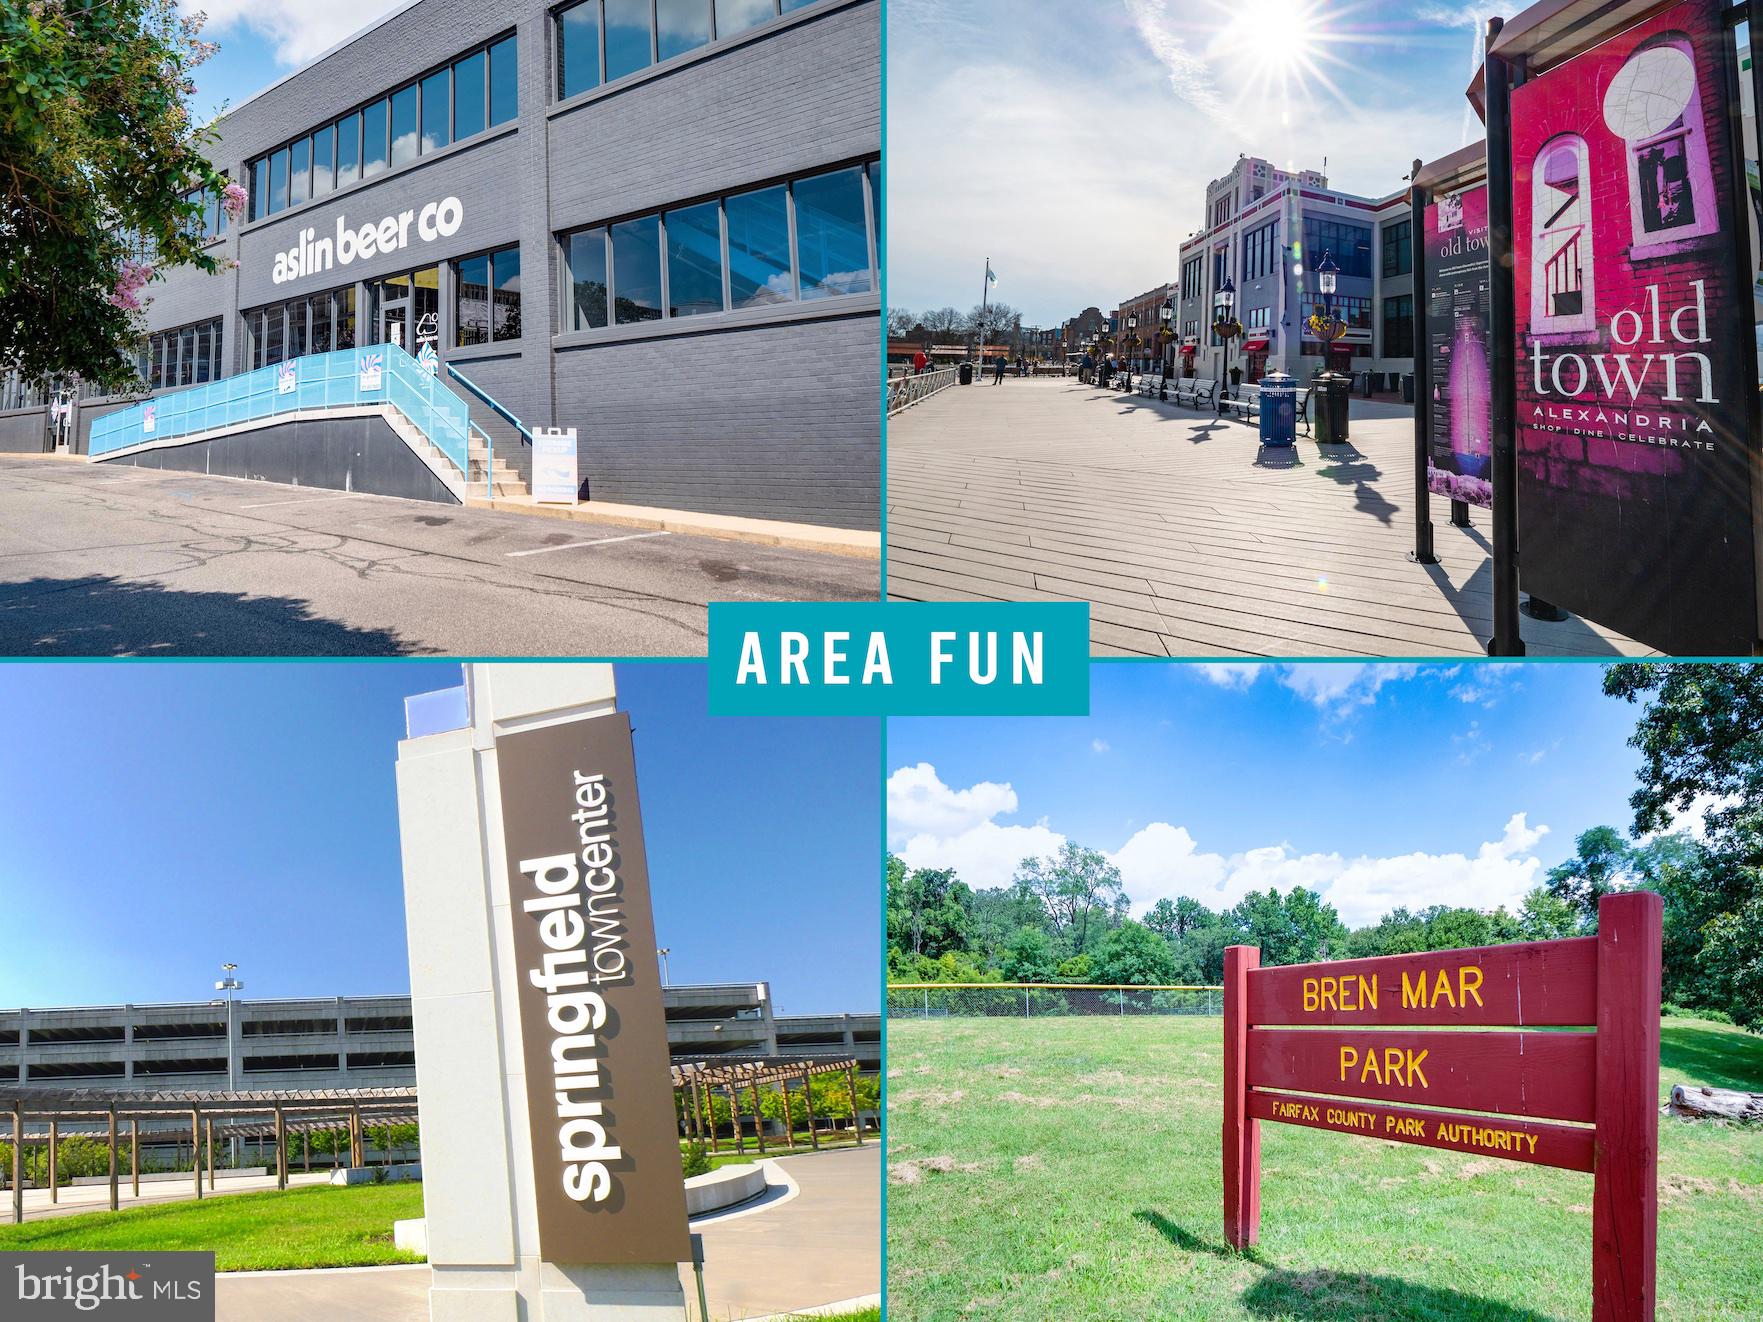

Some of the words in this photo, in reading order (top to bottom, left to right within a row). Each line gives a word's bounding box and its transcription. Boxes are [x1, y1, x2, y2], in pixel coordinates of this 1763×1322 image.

[273, 227, 333, 285] aslin
[336, 208, 414, 265] beer
[418, 196, 464, 242] co
[1440, 235, 1461, 258] old
[1466, 235, 1489, 253] tow
[1468, 225, 1489, 235] VISIT
[1611, 279, 1712, 345] old
[1530, 340, 1720, 404] town
[1533, 406, 1713, 433] ALEXANDRIA
[1533, 423, 1561, 432] SHOP
[1573, 427, 1604, 438] DINE
[1618, 432, 1715, 451] CELEBRATE
[1303, 973, 1378, 1011] BREN
[1401, 965, 1483, 1009] MAR
[519, 851, 622, 1203] springfield
[1340, 1046, 1429, 1088] PARK
[1272, 1101, 1319, 1122] FAIRFAX
[1326, 1108, 1376, 1130] COUNTY
[1386, 1115, 1425, 1138] PARK
[1437, 1122, 1539, 1154] AUTHORITY
